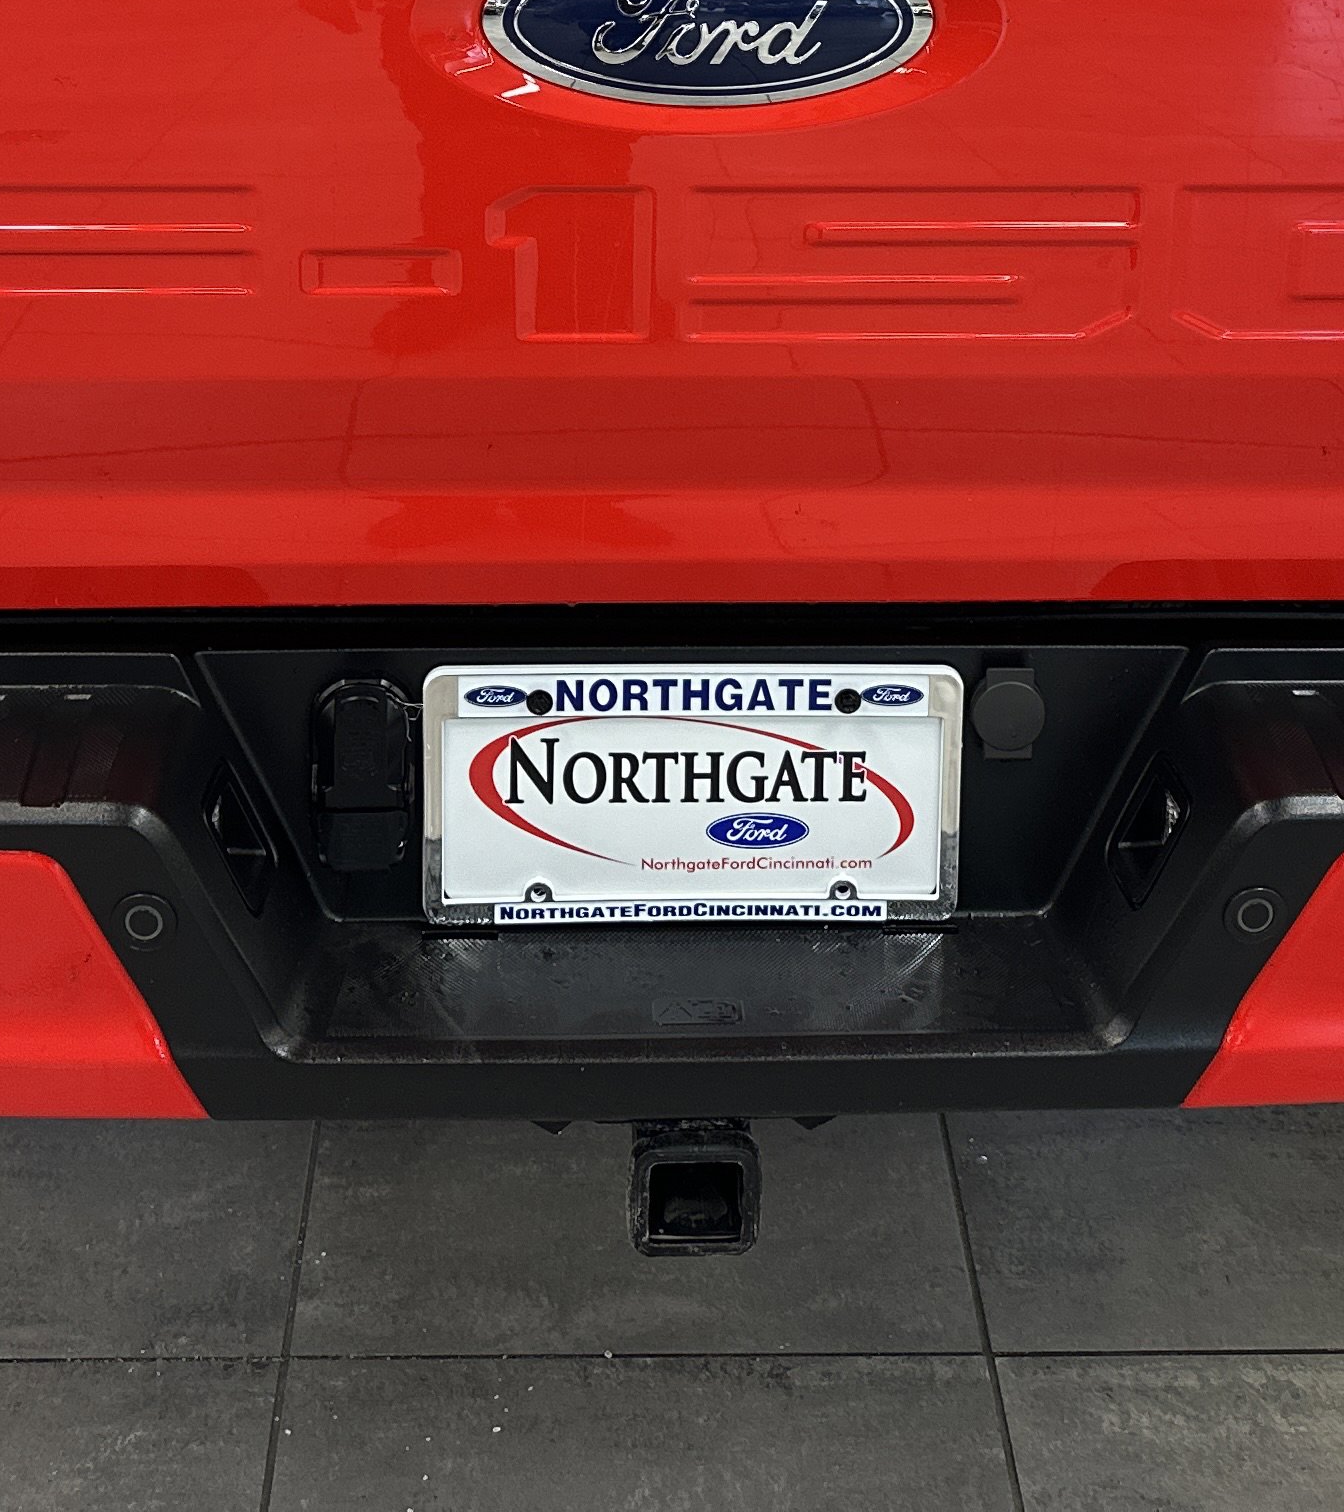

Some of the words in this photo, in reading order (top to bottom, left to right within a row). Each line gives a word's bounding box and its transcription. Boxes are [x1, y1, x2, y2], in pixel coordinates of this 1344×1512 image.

[476, 685, 513, 704] Ford
[556, 679, 832, 712] NORTHGATE
[872, 685, 911, 704] Ford
[725, 819, 788, 843] Ford
[641, 855, 873, 872] NorthgateFordCincinnati.com
